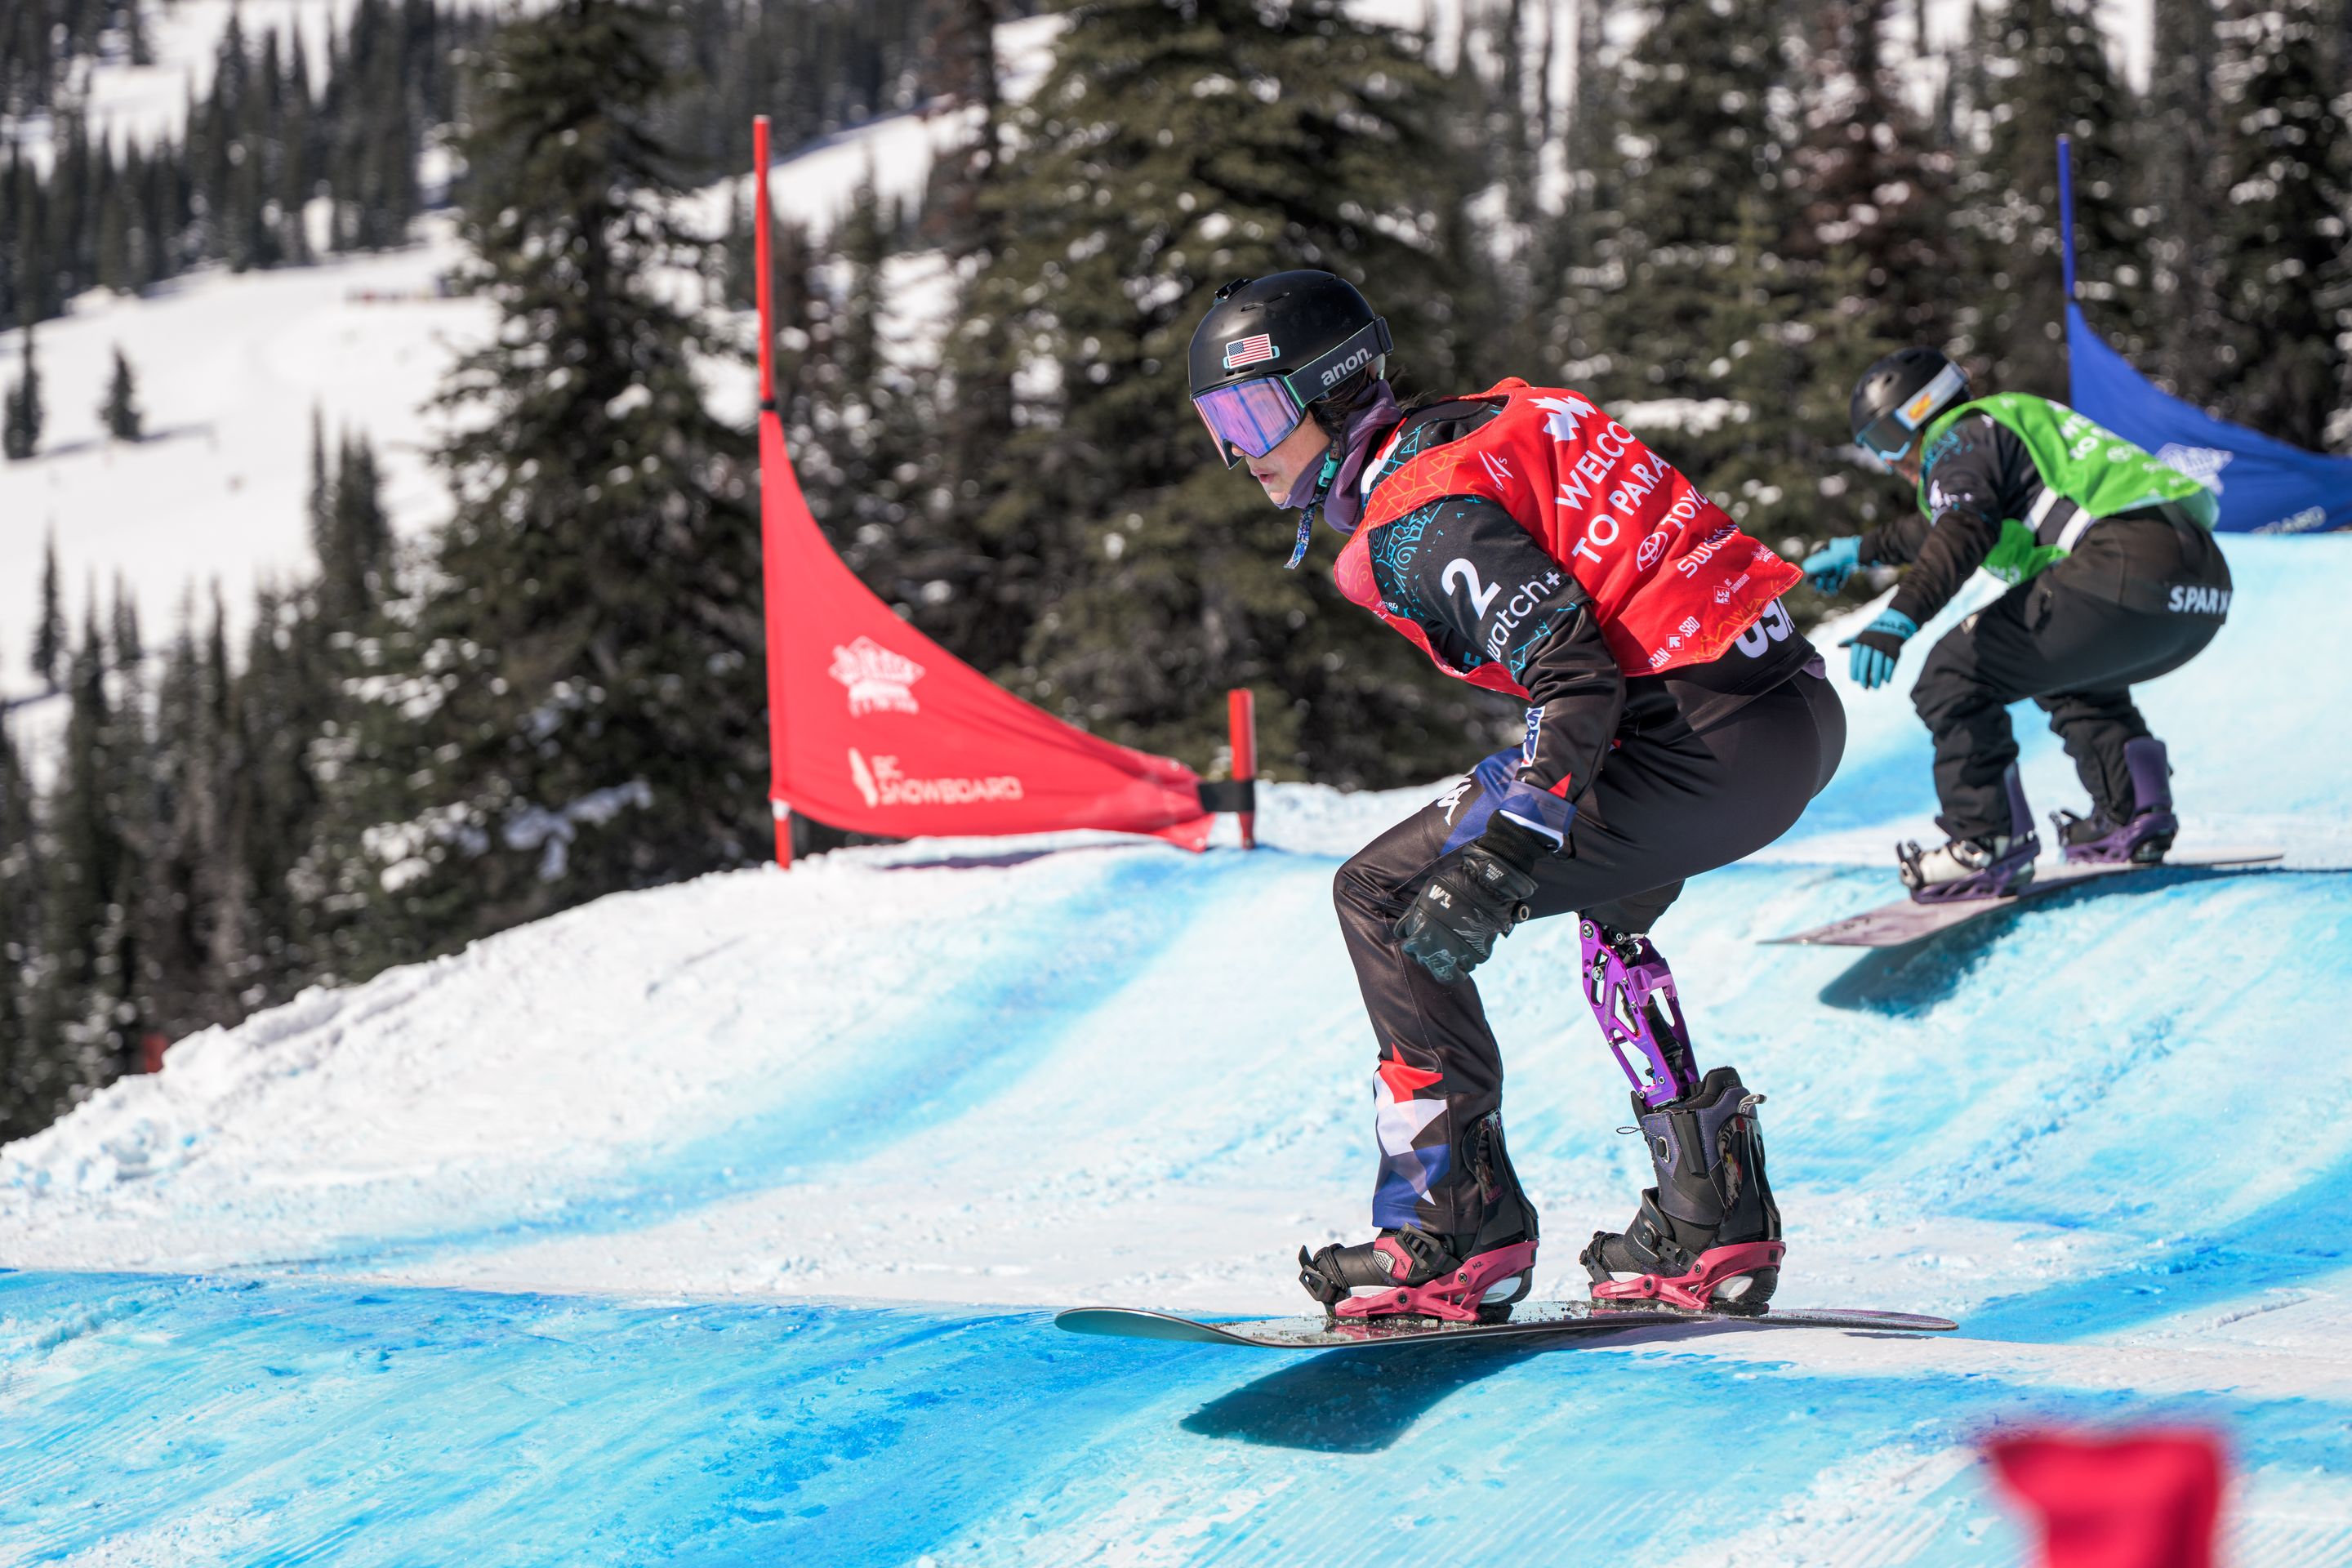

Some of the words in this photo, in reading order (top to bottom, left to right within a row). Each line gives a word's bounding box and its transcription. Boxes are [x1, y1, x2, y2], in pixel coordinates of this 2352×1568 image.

[1321, 348, 1373, 386] anon.
[1554, 421, 1636, 510] WELCO
[1571, 514, 1619, 564] TO
[1608, 449, 1672, 516] PARA
[1441, 558, 1502, 621] 2
[1647, 647, 1672, 668] CAN
[1678, 615, 1701, 638] SBD
